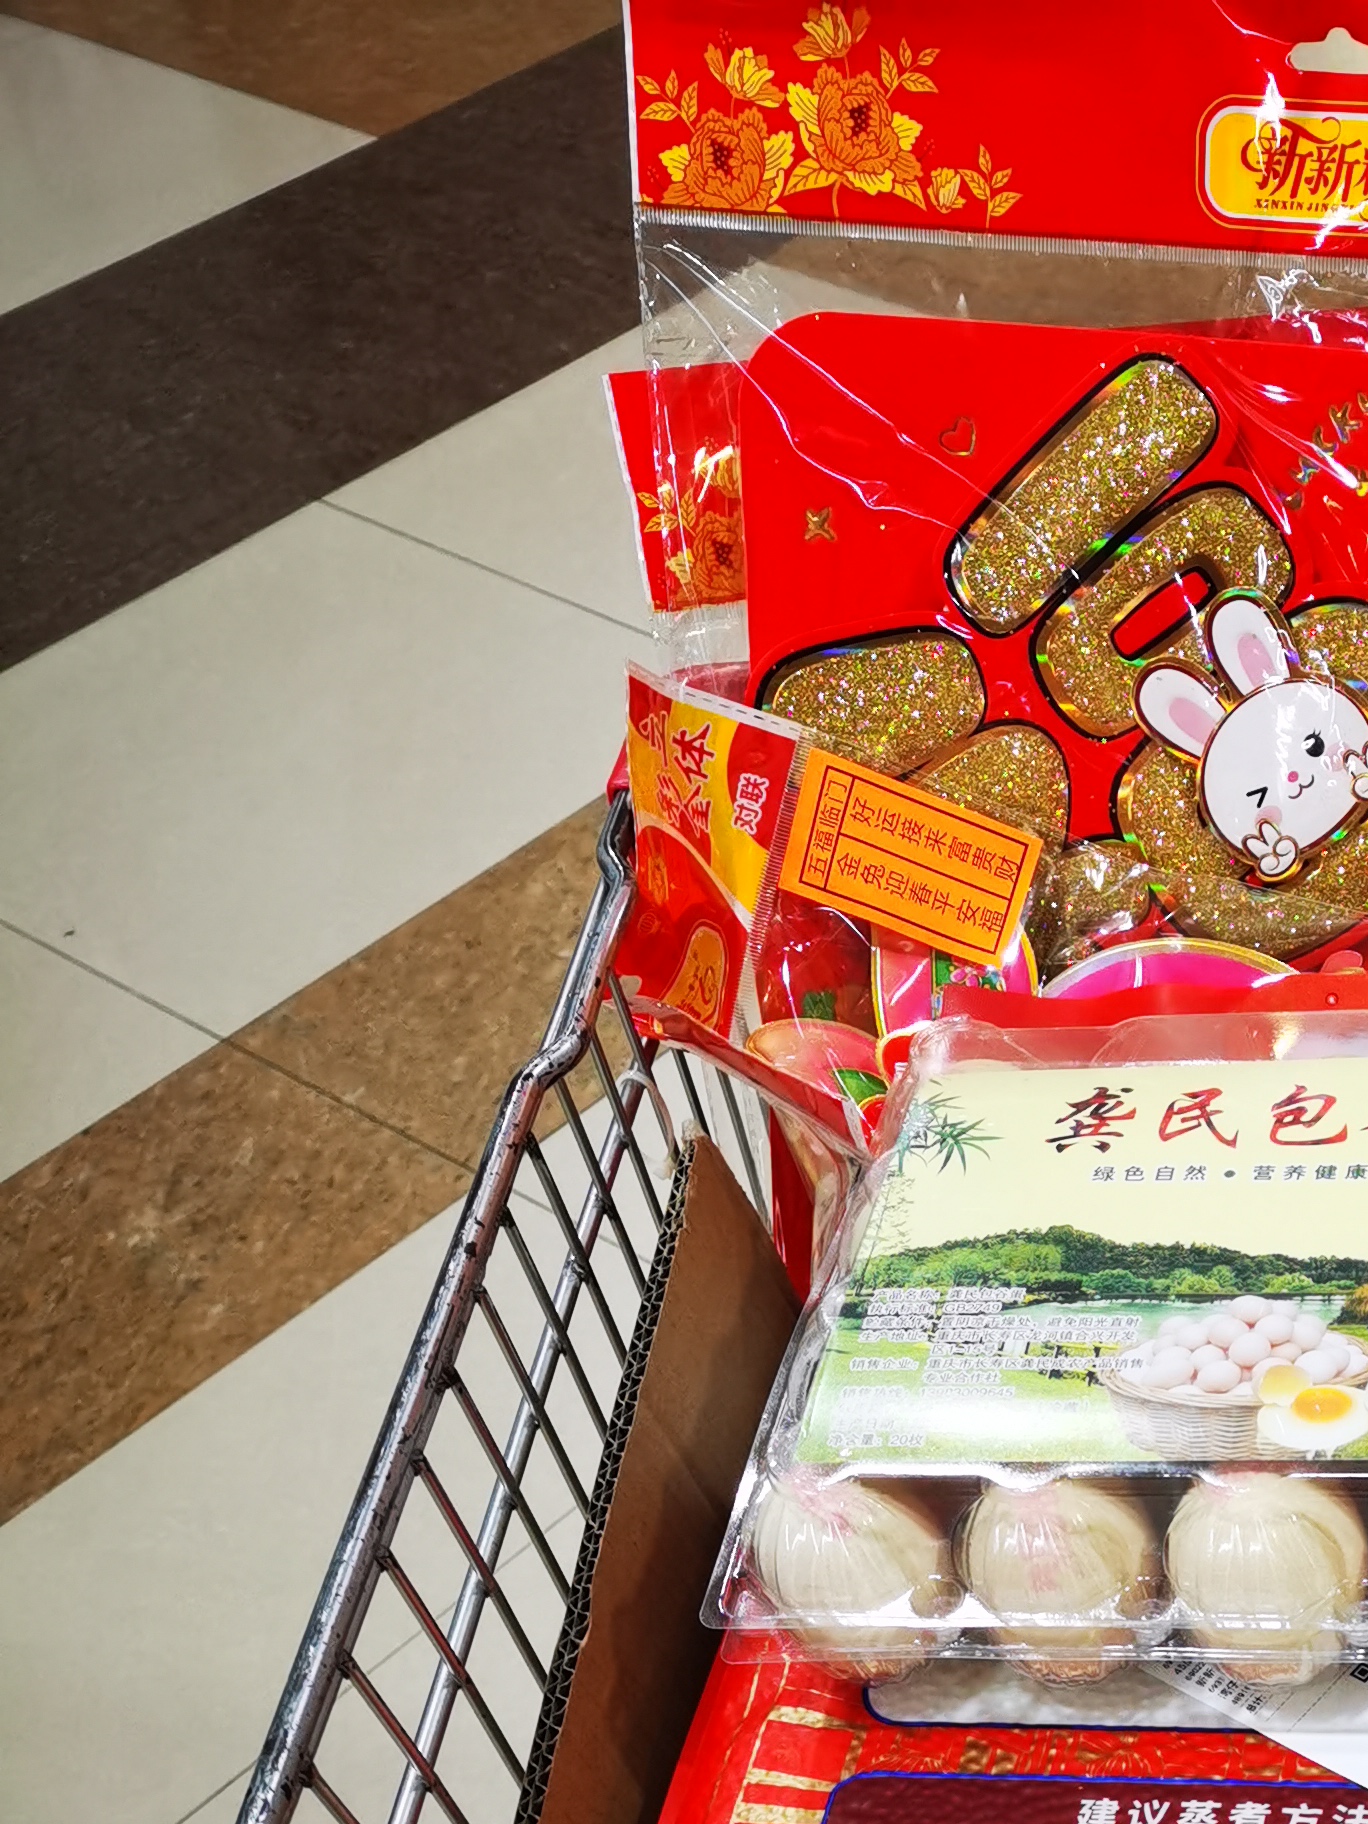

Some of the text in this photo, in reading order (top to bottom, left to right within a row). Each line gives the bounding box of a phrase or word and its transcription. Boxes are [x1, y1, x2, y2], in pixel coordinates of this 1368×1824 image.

[640, 712, 716, 786] 立体
[732, 773, 769, 835] 对联
[807, 780, 848, 878] 五福临门
[836, 852, 1004, 933] 金兔迎春平安福
[1092, 1165, 1208, 1183] 绿色自然
[1252, 1163, 1368, 1181] 营养健康
